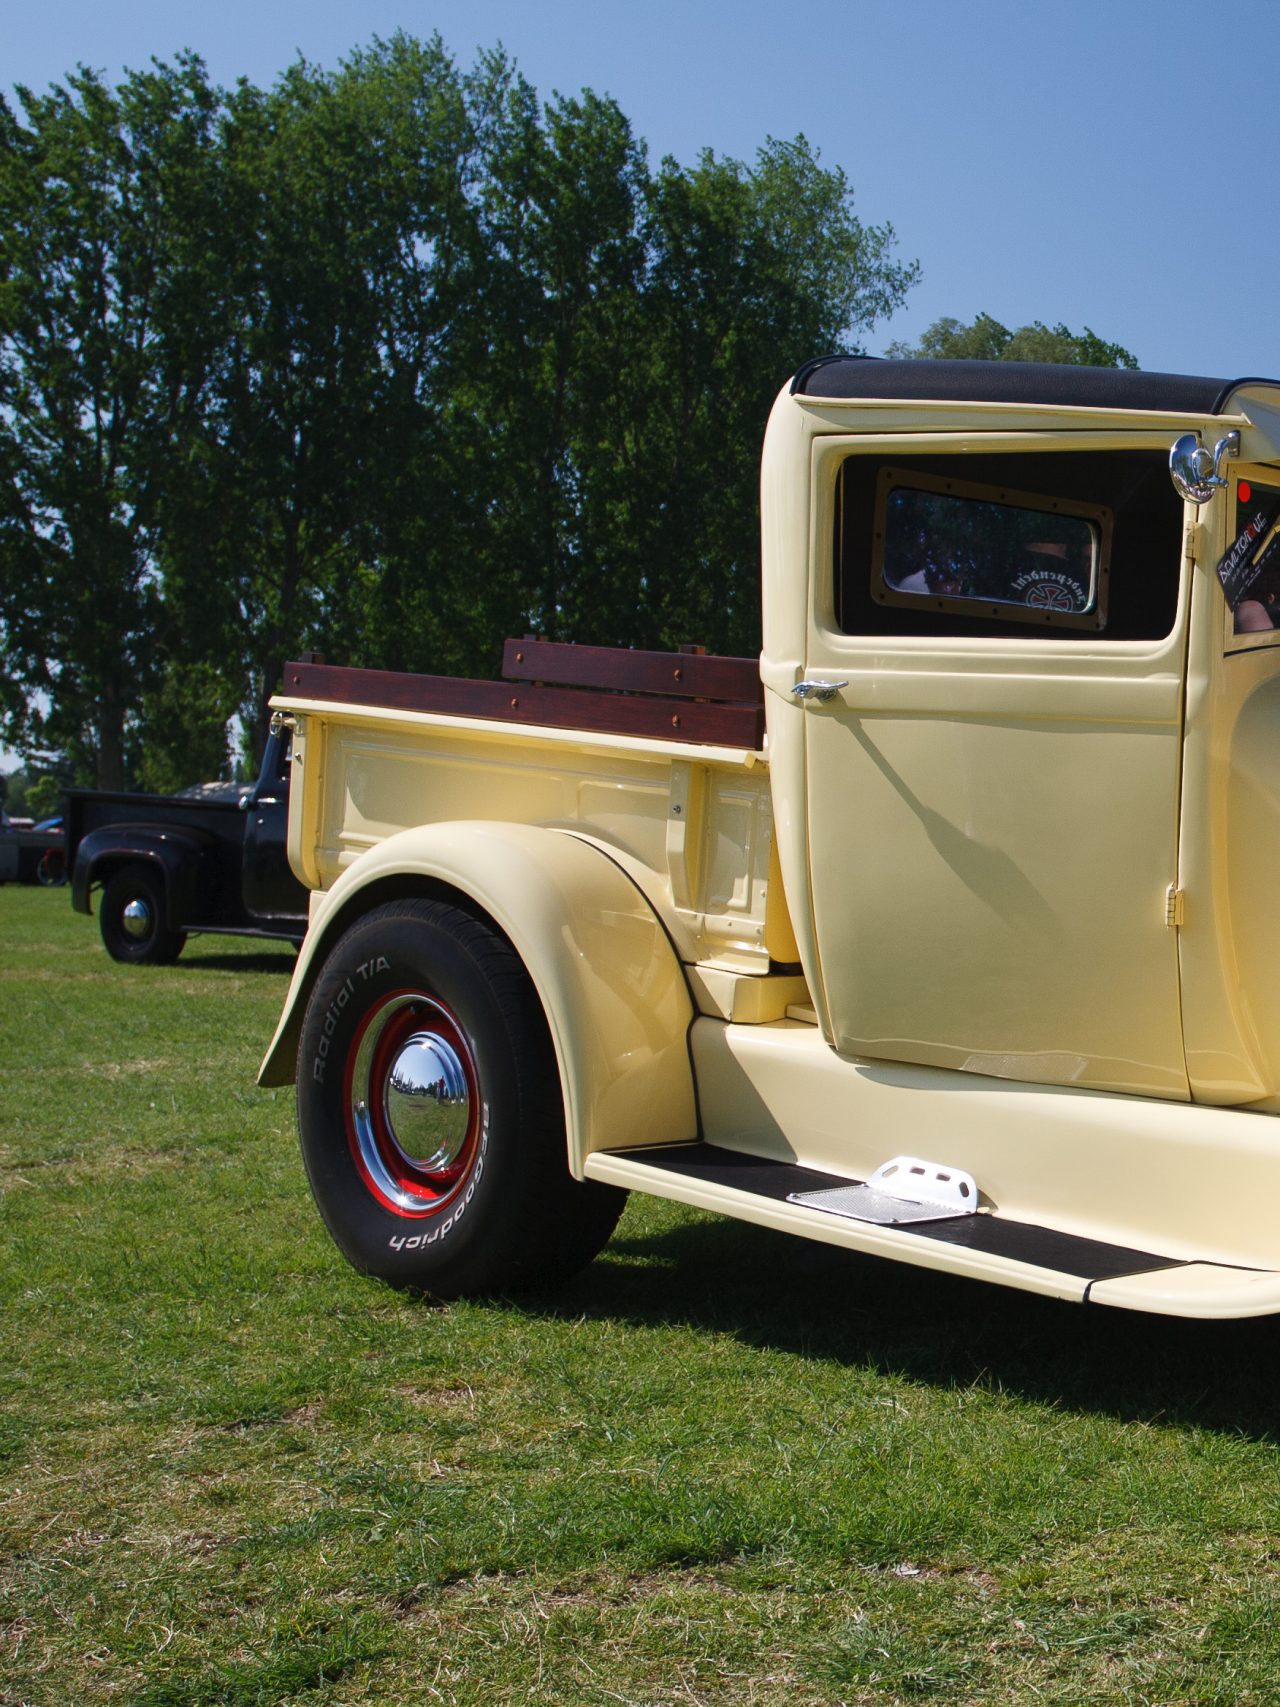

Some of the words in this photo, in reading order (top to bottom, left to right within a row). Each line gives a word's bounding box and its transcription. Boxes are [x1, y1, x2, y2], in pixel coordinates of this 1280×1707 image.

[313, 977, 355, 1084] Radial
[356, 955, 391, 982] T/A
[388, 1102, 490, 1253] BFGoodrich
